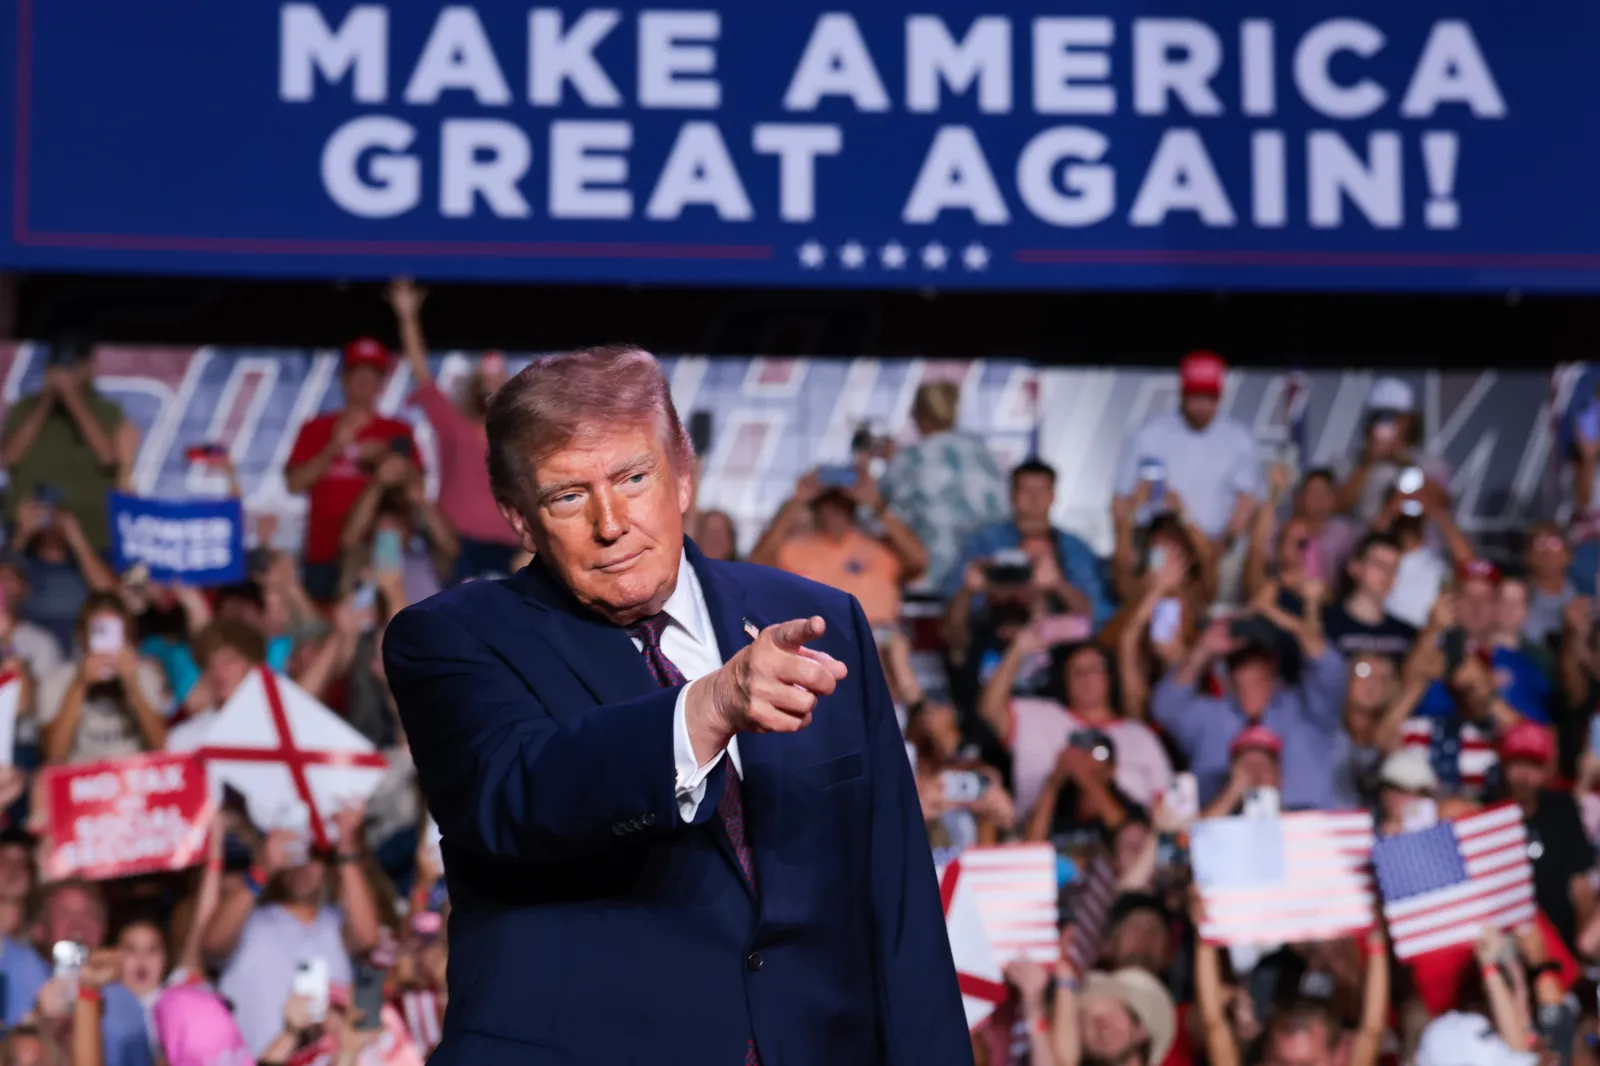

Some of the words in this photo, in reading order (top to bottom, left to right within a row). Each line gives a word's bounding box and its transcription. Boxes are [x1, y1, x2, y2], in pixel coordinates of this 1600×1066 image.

[281, 4, 720, 108] MAKE
[785, 12, 1507, 117] AMERICA
[322, 116, 842, 221] GREAT
[904, 126, 1461, 228] AGAIN!
[118, 512, 231, 539] LOWER
[124, 764, 184, 793] TAX
